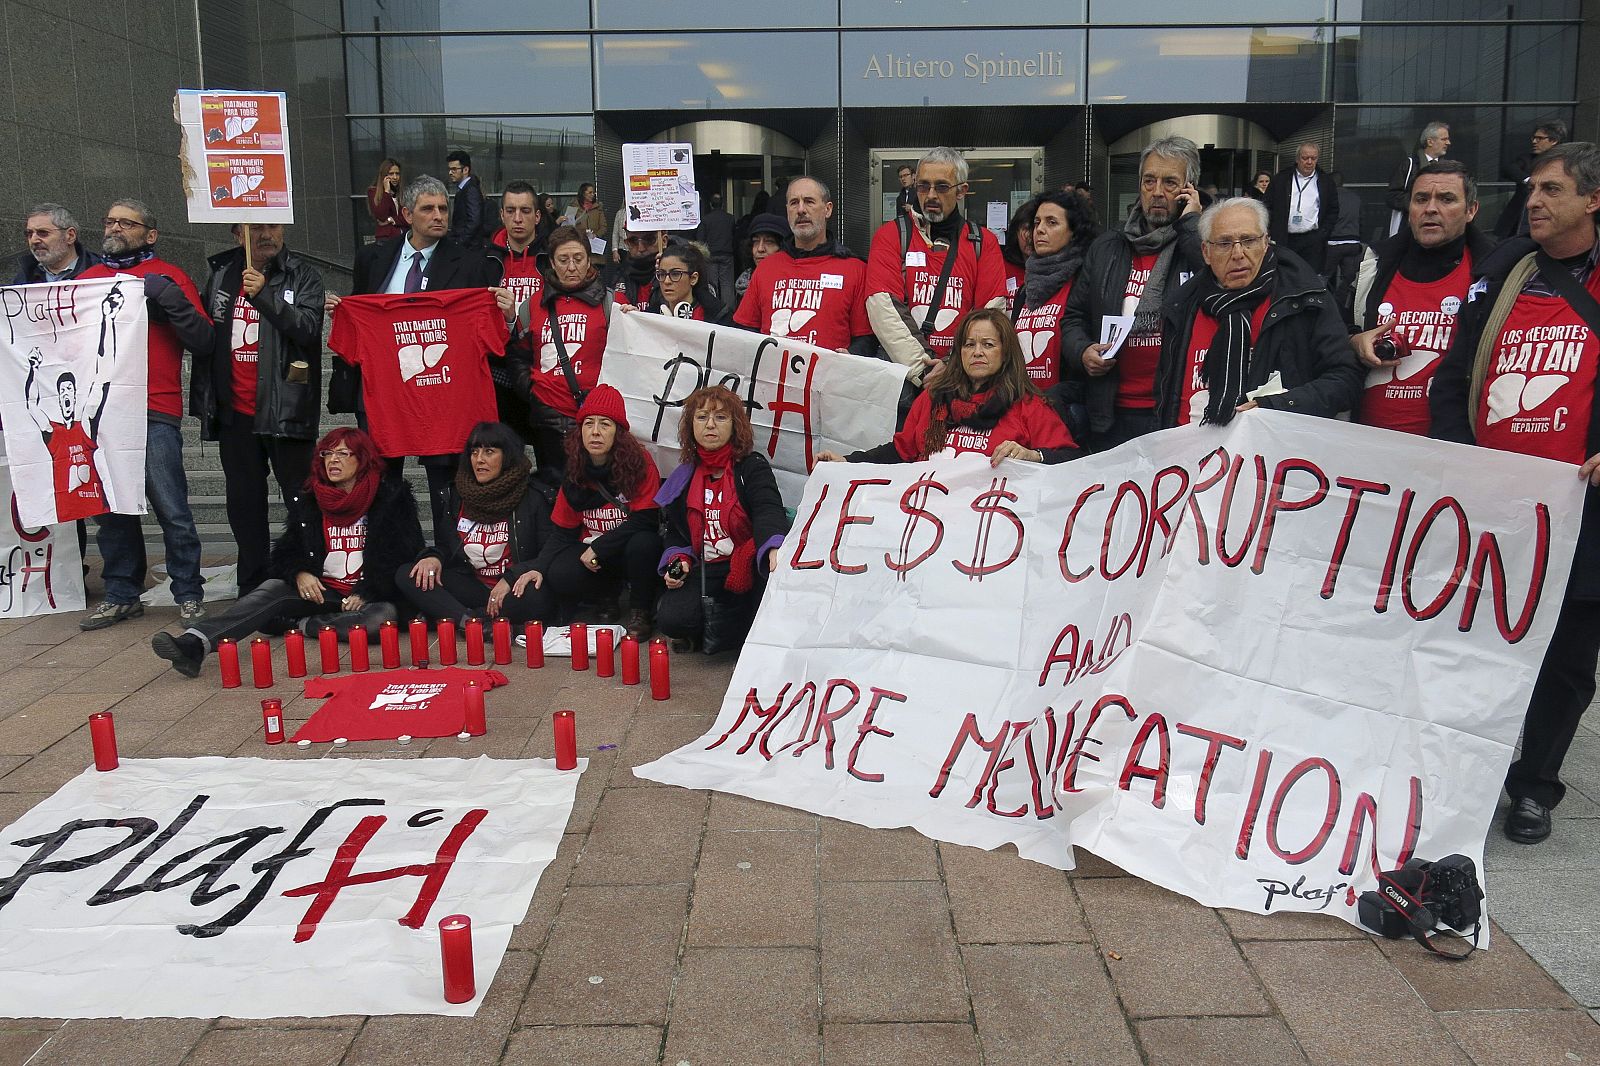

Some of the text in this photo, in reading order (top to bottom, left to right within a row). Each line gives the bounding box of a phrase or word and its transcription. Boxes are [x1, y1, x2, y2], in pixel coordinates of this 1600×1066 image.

[863, 51, 1064, 85] Altiero Spinelli
[508, 277, 541, 287] RECORTES
[774, 279, 787, 290] LOS
[915, 271, 929, 283] LOS
[772, 289, 823, 310] MATAN
[912, 283, 963, 309] MAAN
[392, 318, 447, 333] TRATAMIENTO
[1399, 311, 1455, 325] RECORTES
[395, 329, 447, 345] PARA TOD@S
[1501, 325, 1589, 345] LOS RECORTES
[1495, 340, 1584, 375] MATAN
[442, 365, 451, 384] C
[1385, 389, 1423, 399] HEPATITIS
[1510, 406, 1568, 433] HEPATITIS C
[957, 434, 989, 451] TOD@S
[791, 446, 1552, 645] LE$$ CORRUPTION
[1038, 611, 1133, 687] AND
[704, 678, 908, 783] MORE
[1385, 886, 1409, 908] Canon
